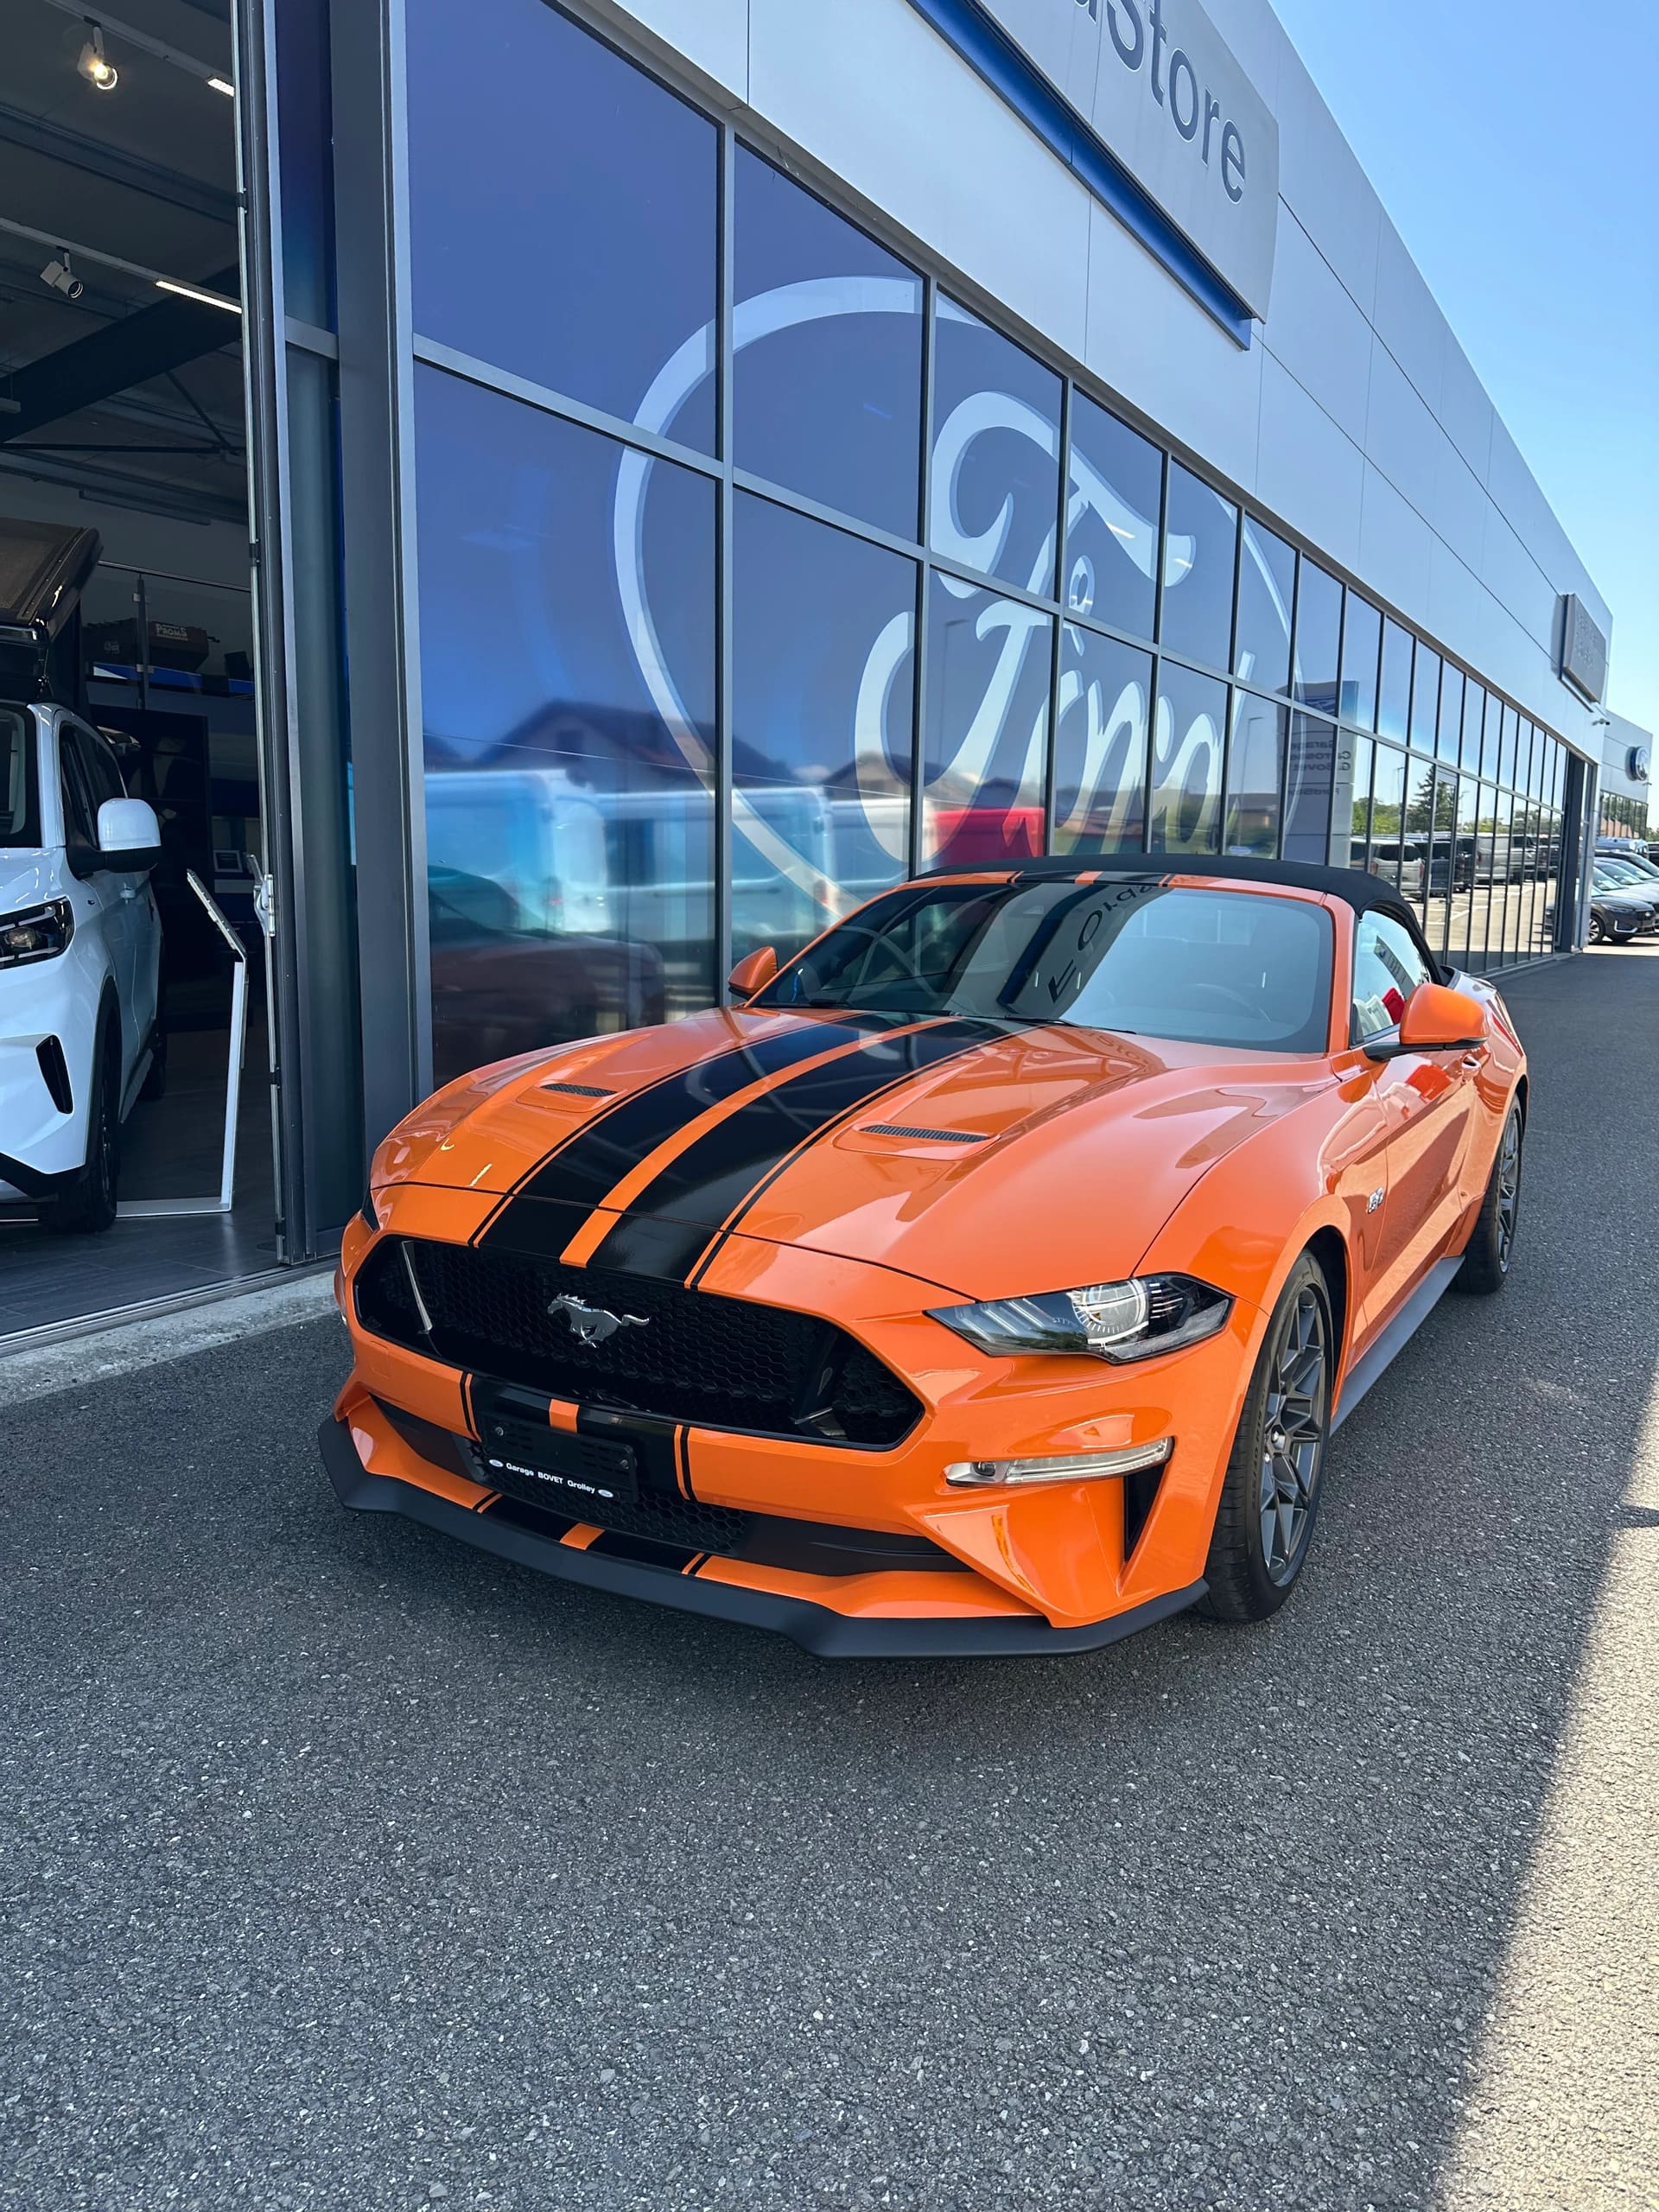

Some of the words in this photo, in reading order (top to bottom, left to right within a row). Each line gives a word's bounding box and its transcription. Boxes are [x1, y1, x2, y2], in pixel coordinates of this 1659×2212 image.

[1076, 0, 1246, 204] Store
[505, 1462, 535, 1477] Garage
[537, 1471, 564, 1484] BOVET
[567, 1479, 595, 1494] Grolley
